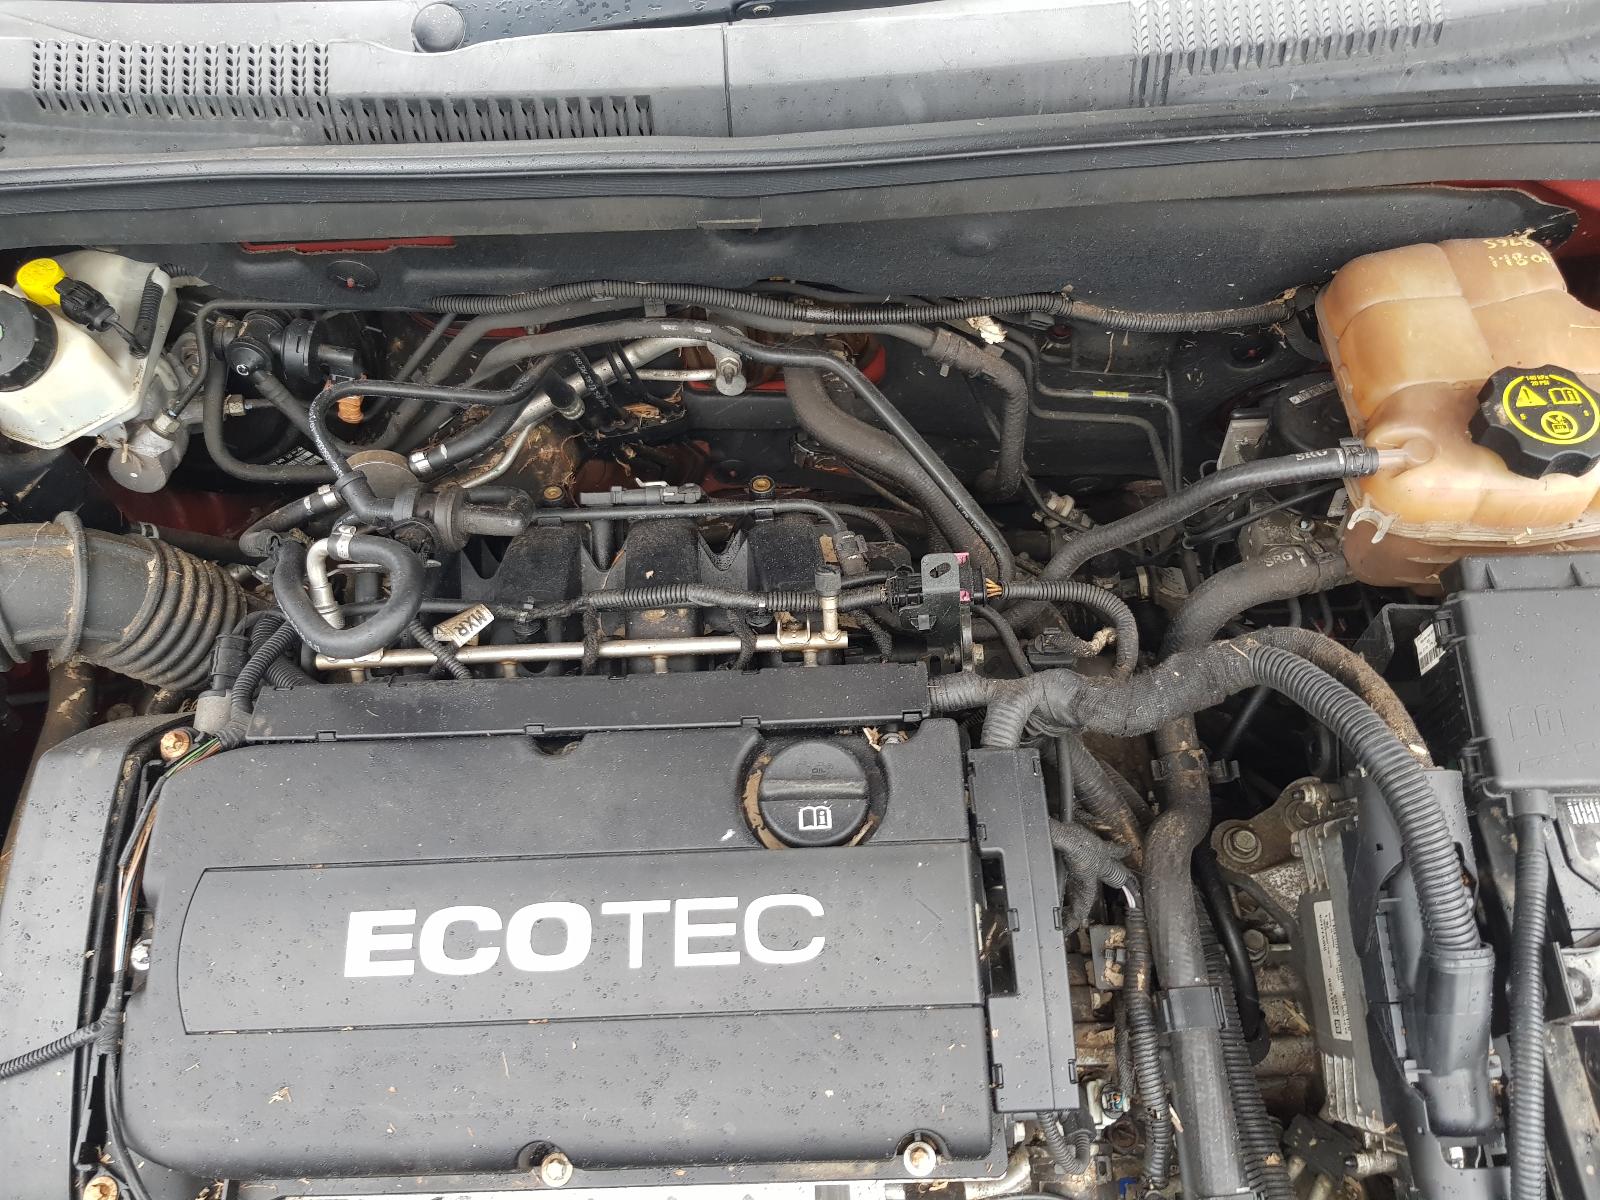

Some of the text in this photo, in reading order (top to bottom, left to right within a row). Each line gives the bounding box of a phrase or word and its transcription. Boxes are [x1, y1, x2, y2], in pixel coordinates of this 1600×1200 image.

[1263, 551, 1293, 567] SRG
[453, 609, 488, 637] MXR
[344, 894, 826, 978] ECOTEC
